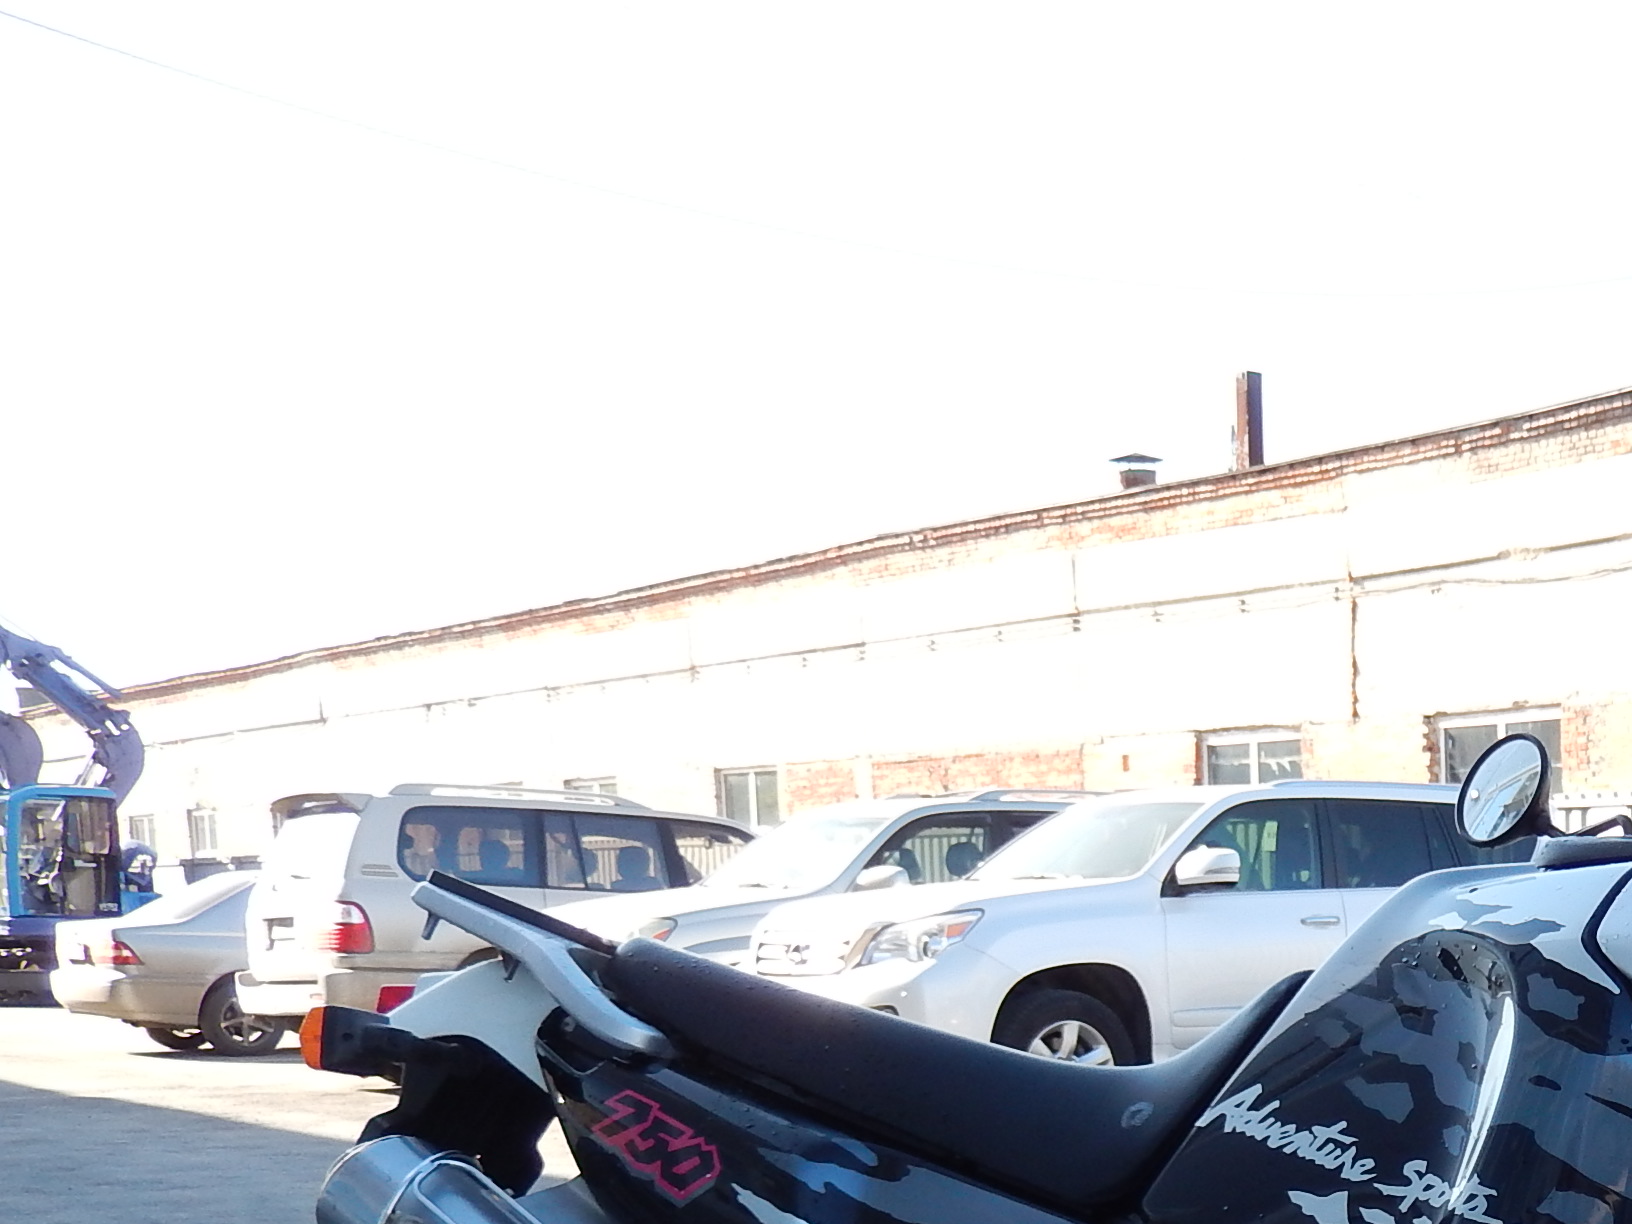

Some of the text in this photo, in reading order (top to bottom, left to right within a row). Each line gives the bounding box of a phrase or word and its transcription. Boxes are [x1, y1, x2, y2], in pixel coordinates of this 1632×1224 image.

[591, 1089, 722, 1203] 750
[1195, 1083, 1504, 1224] Adventure Sports
